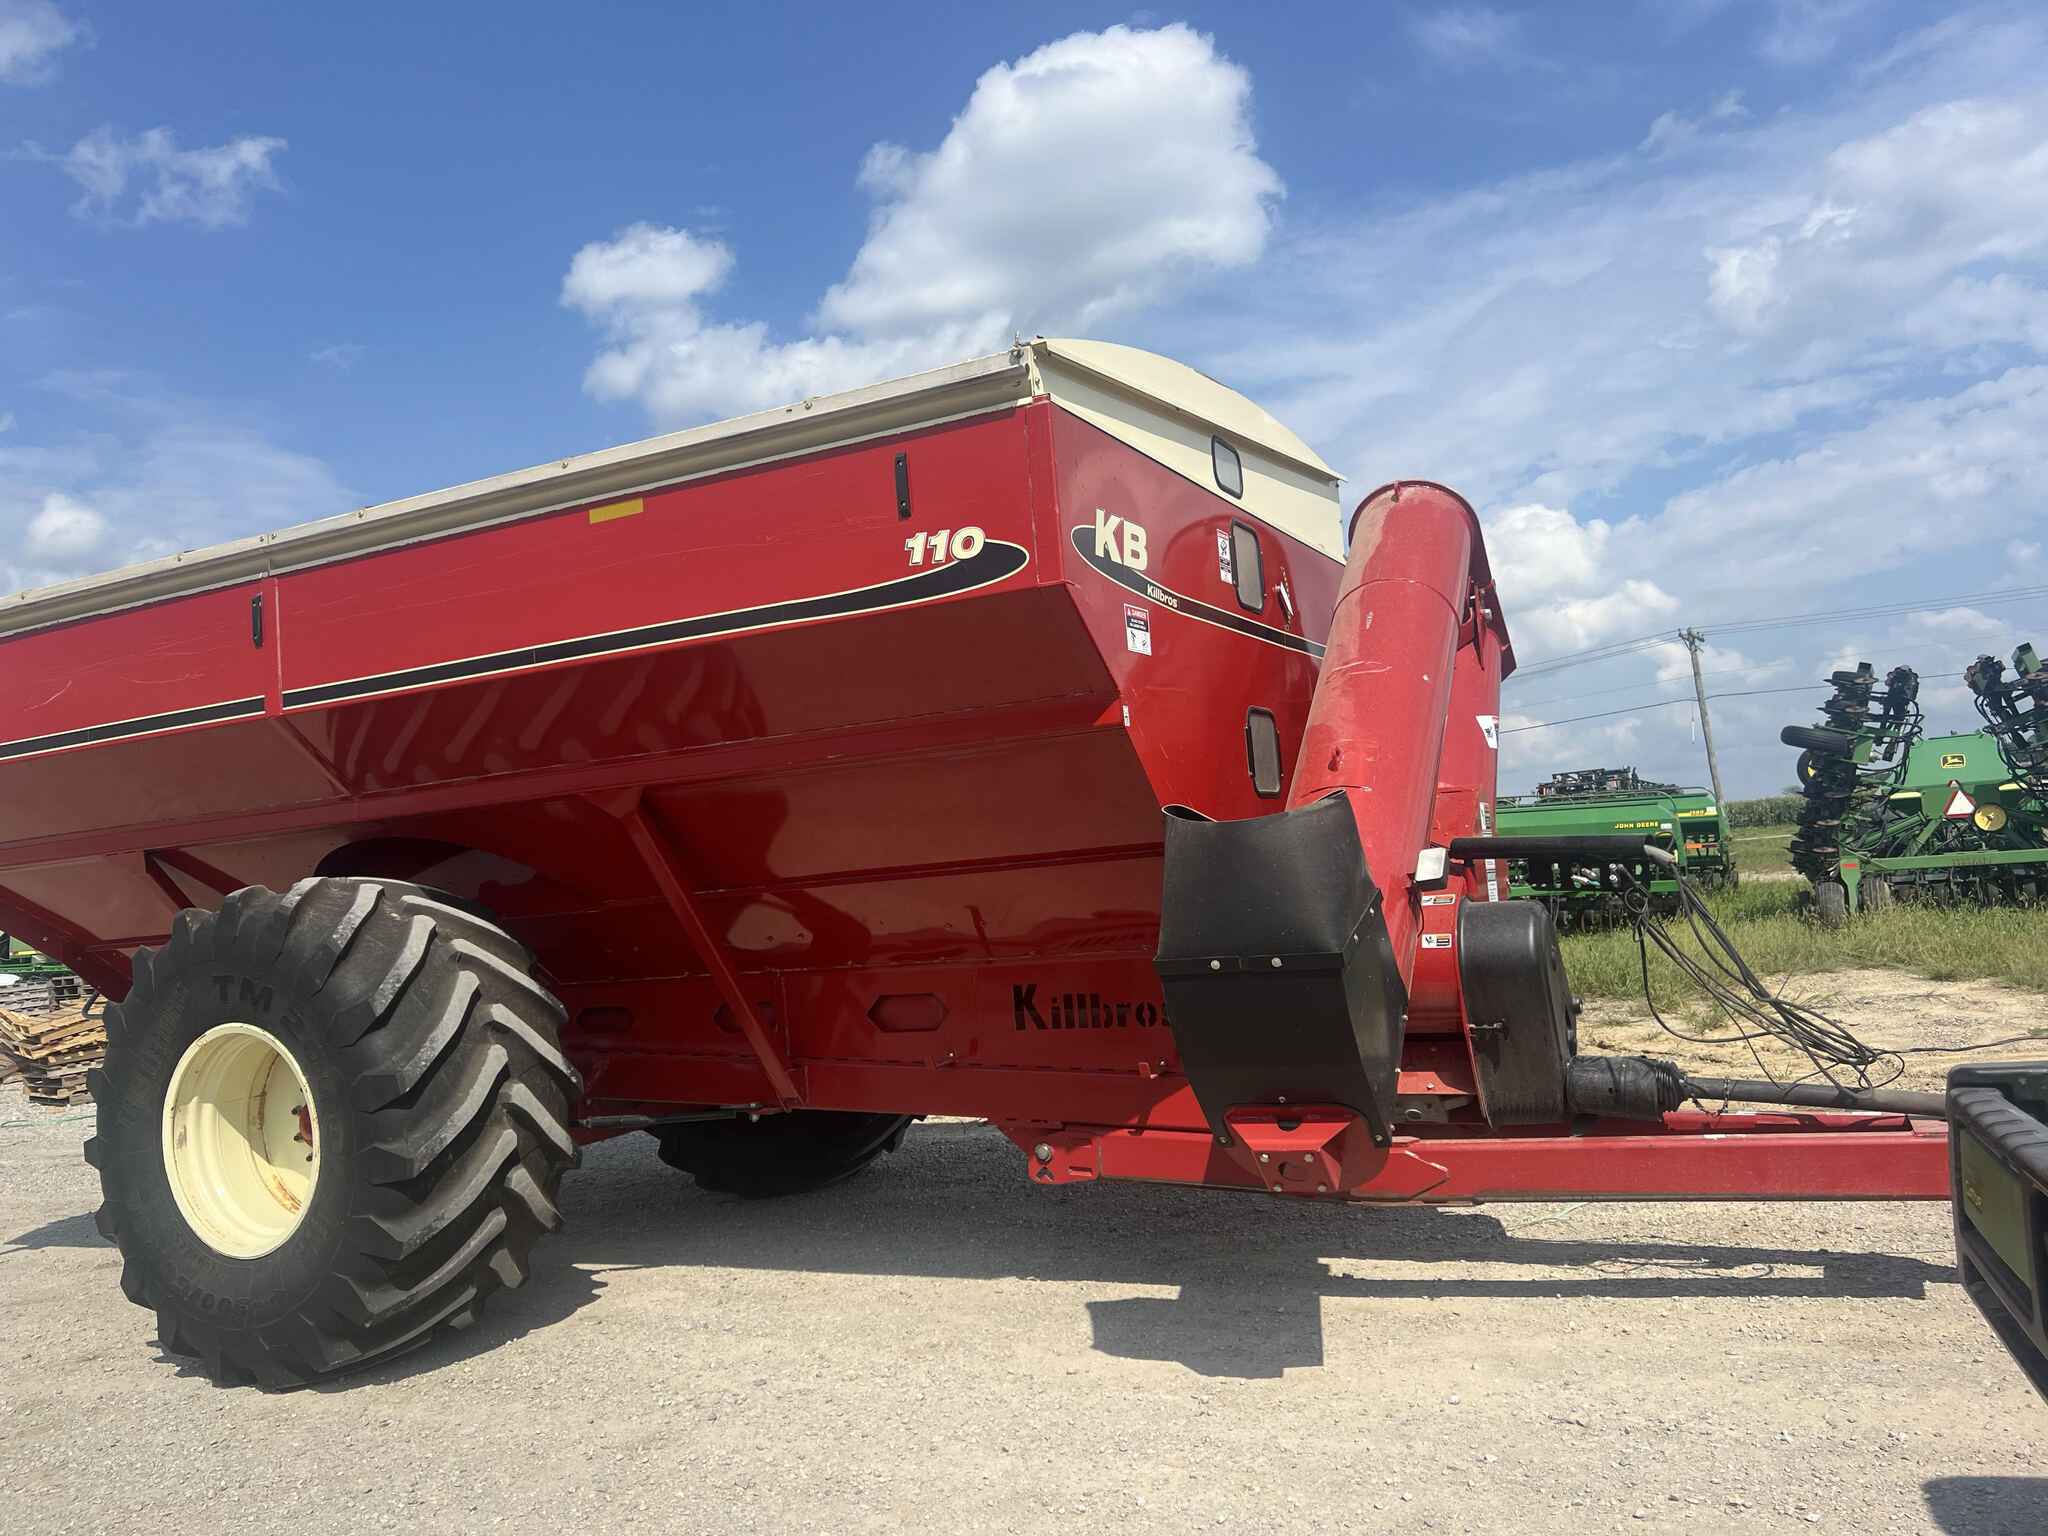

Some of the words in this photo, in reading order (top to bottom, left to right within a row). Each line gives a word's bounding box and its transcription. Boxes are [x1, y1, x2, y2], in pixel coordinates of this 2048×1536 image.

[904, 526, 986, 567] 110
[1095, 506, 1148, 572] KB
[1146, 583, 1178, 608] Killbros
[211, 974, 273, 1012] TM
